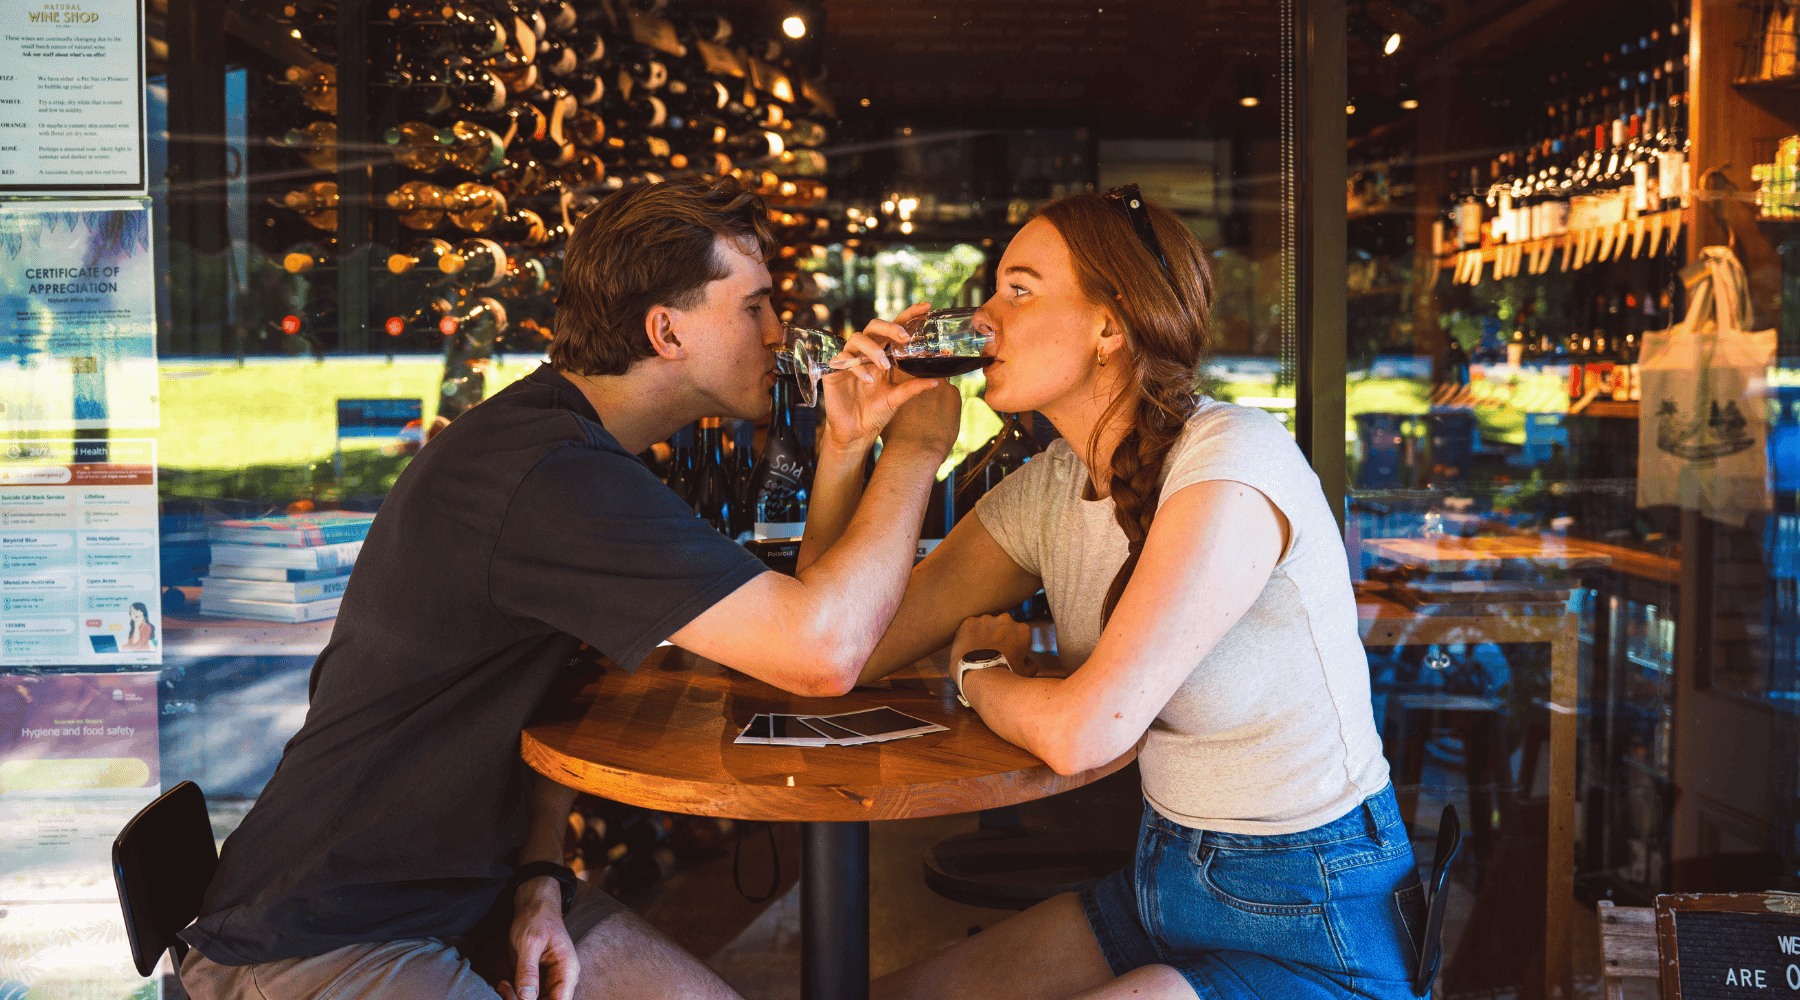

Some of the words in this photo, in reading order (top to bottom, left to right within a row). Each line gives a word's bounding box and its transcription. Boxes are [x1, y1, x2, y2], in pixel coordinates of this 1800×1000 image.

[28, 11, 60, 23] WINE
[63, 11, 99, 23] SHOP
[25, 267, 99, 279] CERTIFICATE
[103, 267, 120, 278] OF
[29, 283, 117, 294] APPRECIATION
[79, 447, 108, 456] Health
[770, 454, 803, 480] Sold
[767, 550, 793, 558] Polaroid
[21, 727, 60, 739] Hygiene
[62, 726, 80, 735] and
[83, 726, 104, 735] food
[107, 725, 135, 737] safety
[51, 762, 109, 774] Excellent
[1777, 935, 1800, 955] WE
[1725, 967, 1767, 989] ARE
